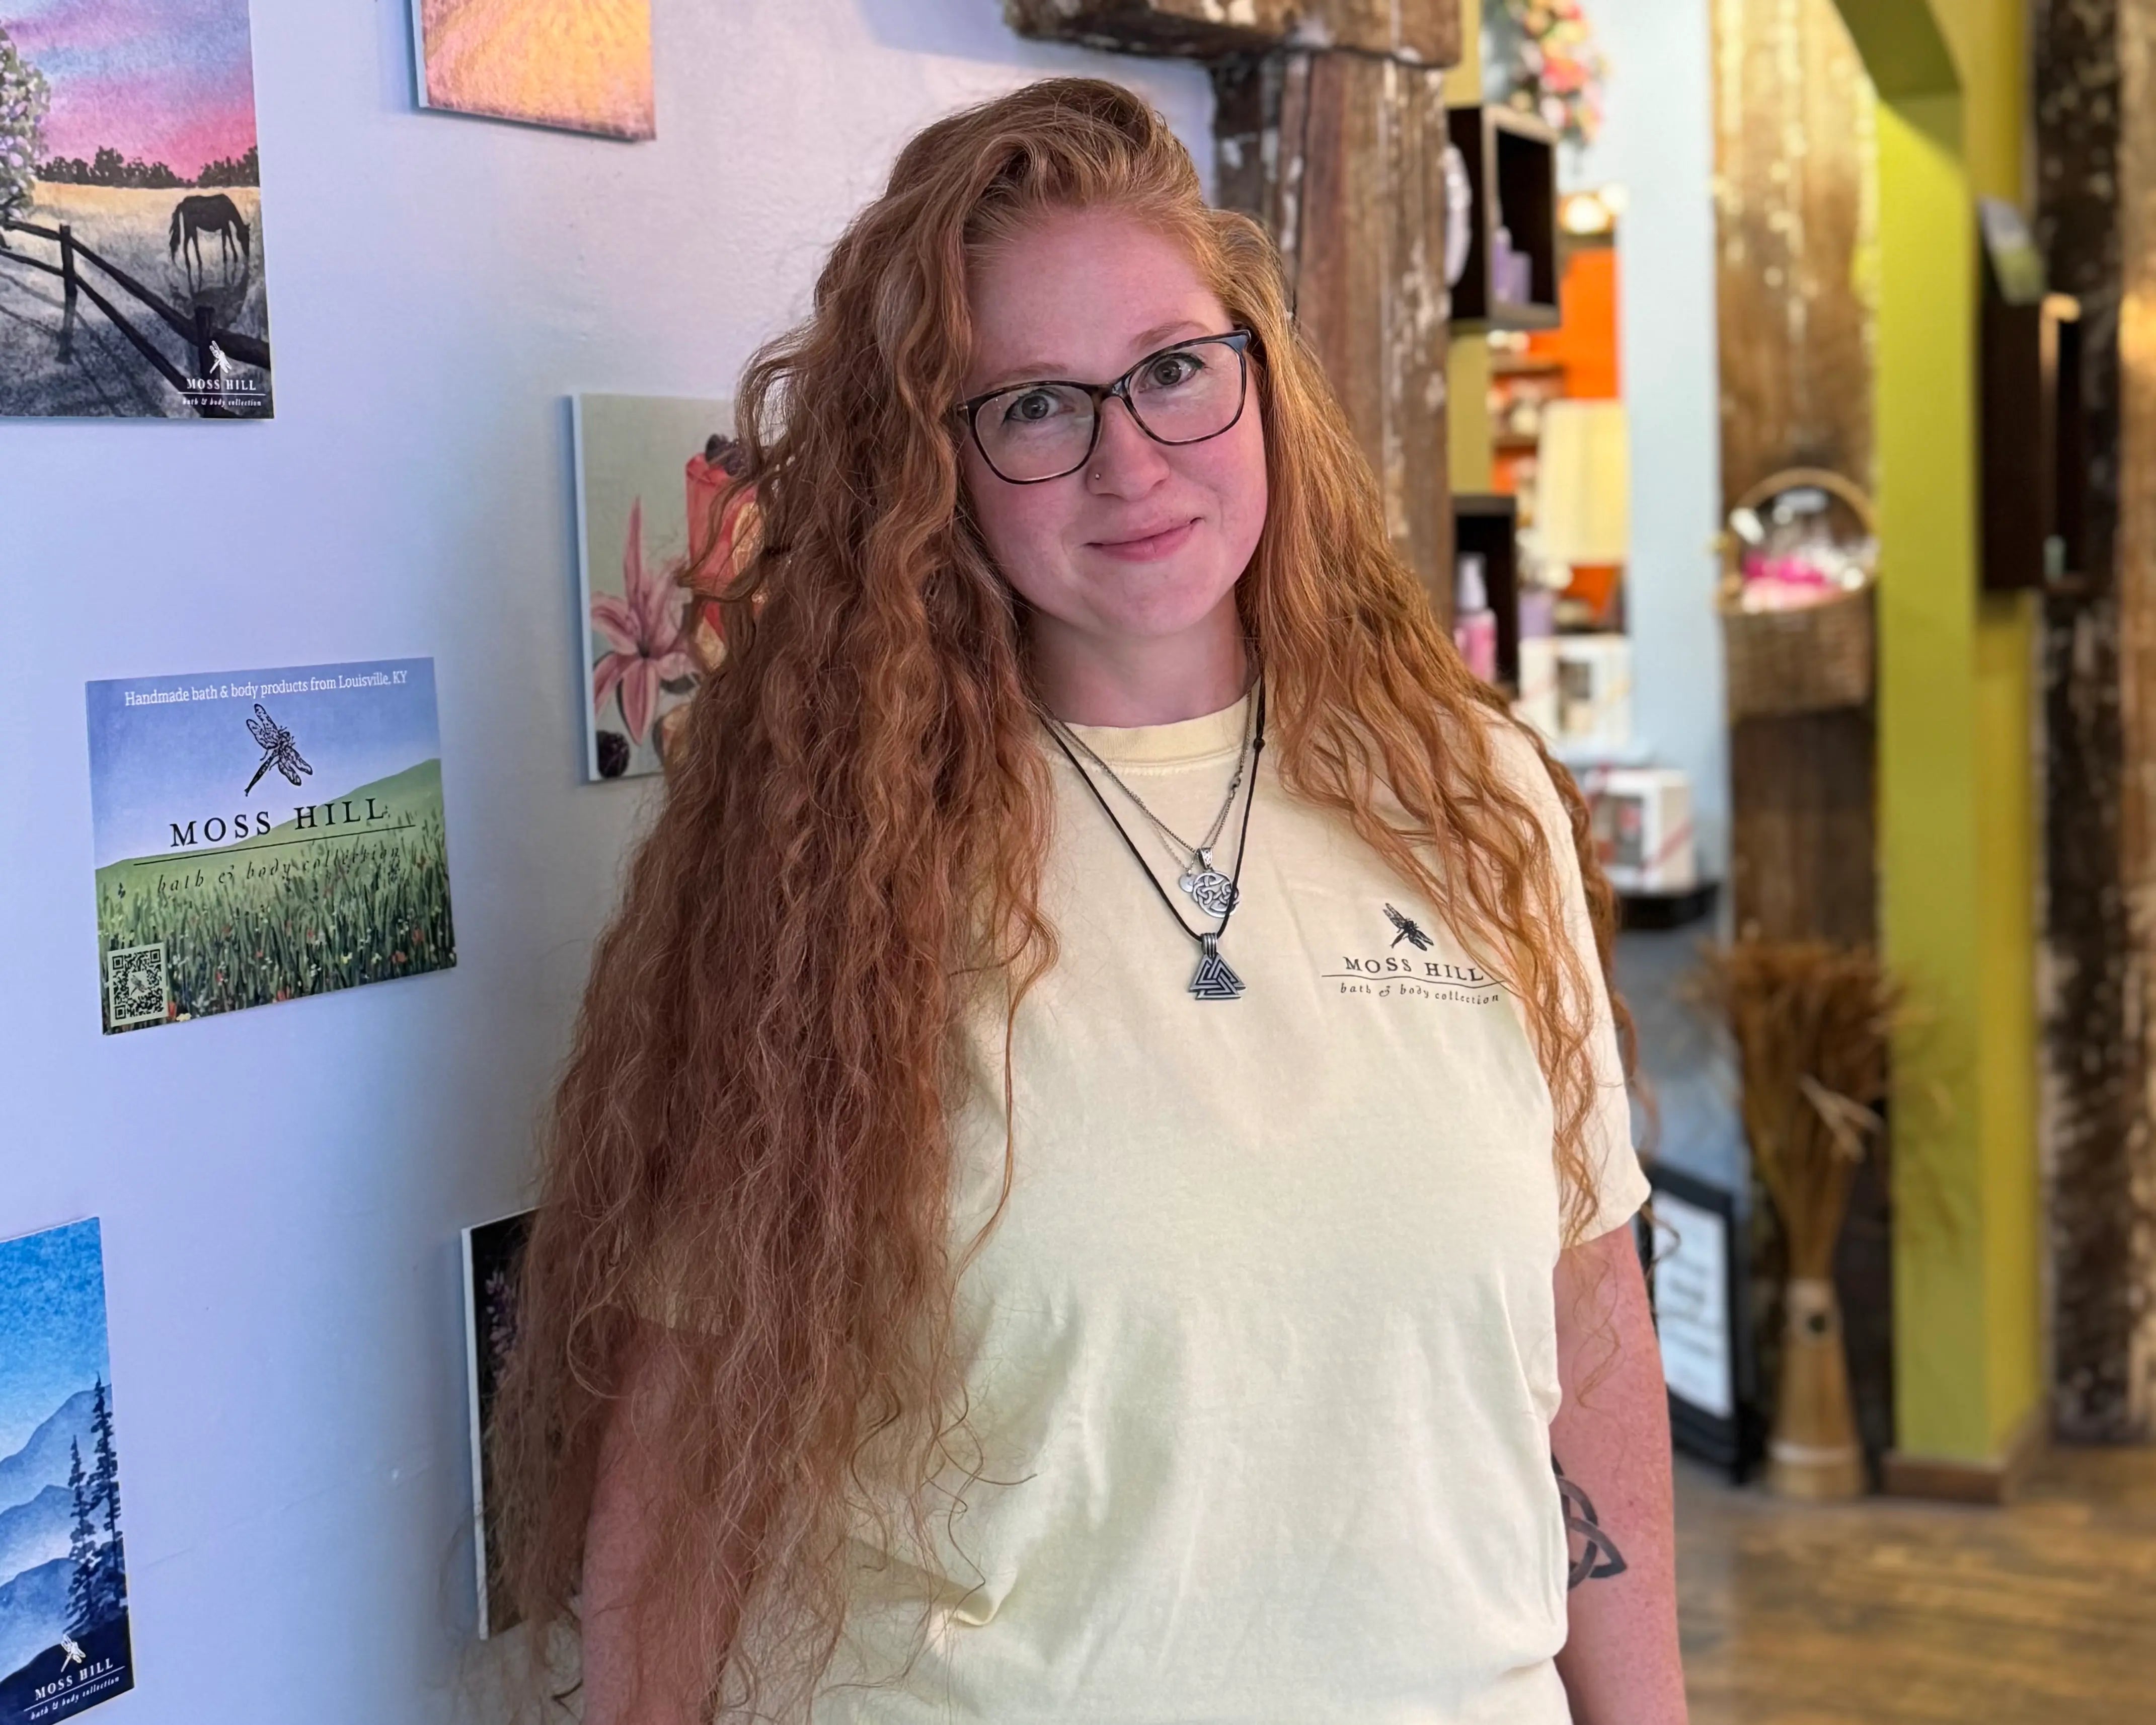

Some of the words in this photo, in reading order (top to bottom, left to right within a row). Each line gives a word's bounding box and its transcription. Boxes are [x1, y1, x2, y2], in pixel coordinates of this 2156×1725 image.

[187, 379, 220, 390] MOSS
[226, 380, 256, 391] HILL
[210, 397, 225, 408] body
[228, 398, 261, 406] collection
[125, 687, 190, 706] Handmade
[191, 685, 217, 701] bath
[220, 685, 228, 698] &
[231, 682, 259, 700] body
[261, 680, 309, 698] products
[311, 677, 337, 691] from
[393, 670, 408, 684] KY
[170, 811, 271, 847] MOSS
[293, 798, 386, 830] HILL
[158, 869, 204, 893] bath
[247, 858, 291, 881] body
[1343, 956, 1412, 973] MOSS
[1424, 962, 1484, 982] HILL
[1340, 983, 1371, 994] bath
[1400, 984, 1429, 999] body
[1435, 991, 1499, 1005] collection
[35, 1675, 73, 1701] MOSS
[80, 1658, 113, 1681] HILL
[30, 1706, 49, 1720] bath
[62, 1693, 79, 1706] body
[83, 1676, 120, 1697] collection
